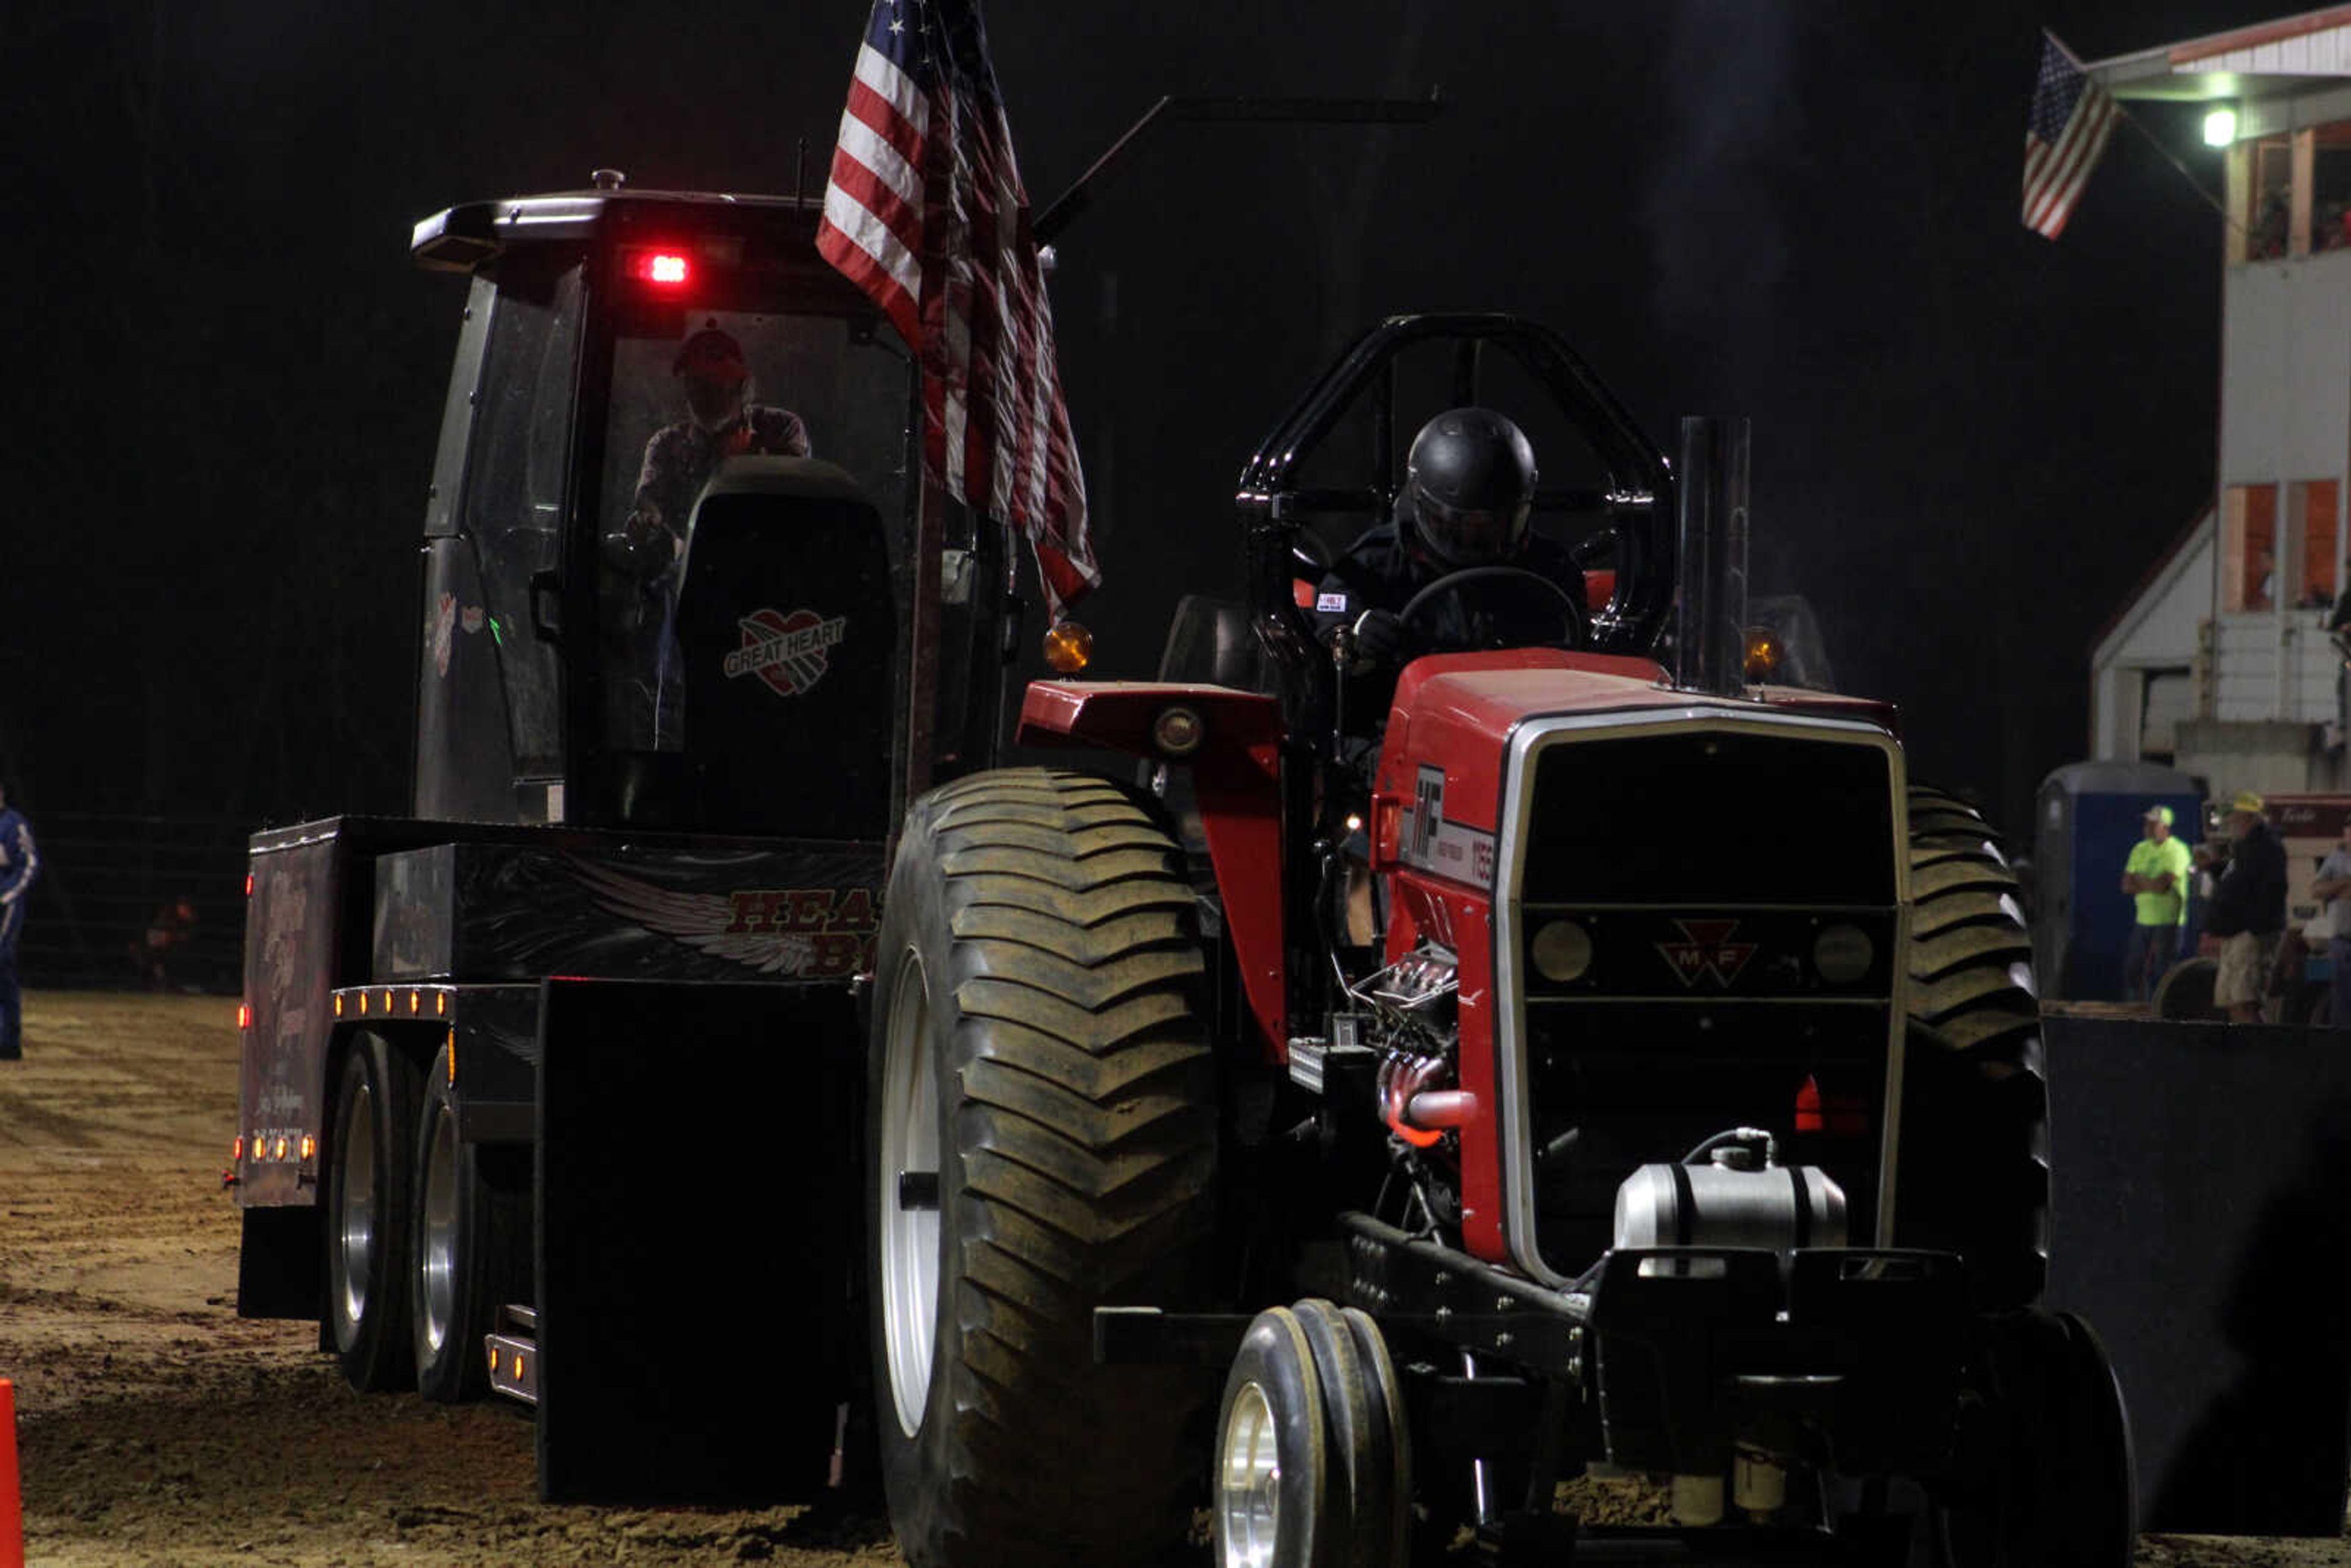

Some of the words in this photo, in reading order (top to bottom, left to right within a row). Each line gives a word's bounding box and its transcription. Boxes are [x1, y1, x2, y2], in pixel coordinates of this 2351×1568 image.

[725, 639, 787, 673] GREAT
[787, 620, 844, 659] HEART
[727, 889, 884, 932] HEA
